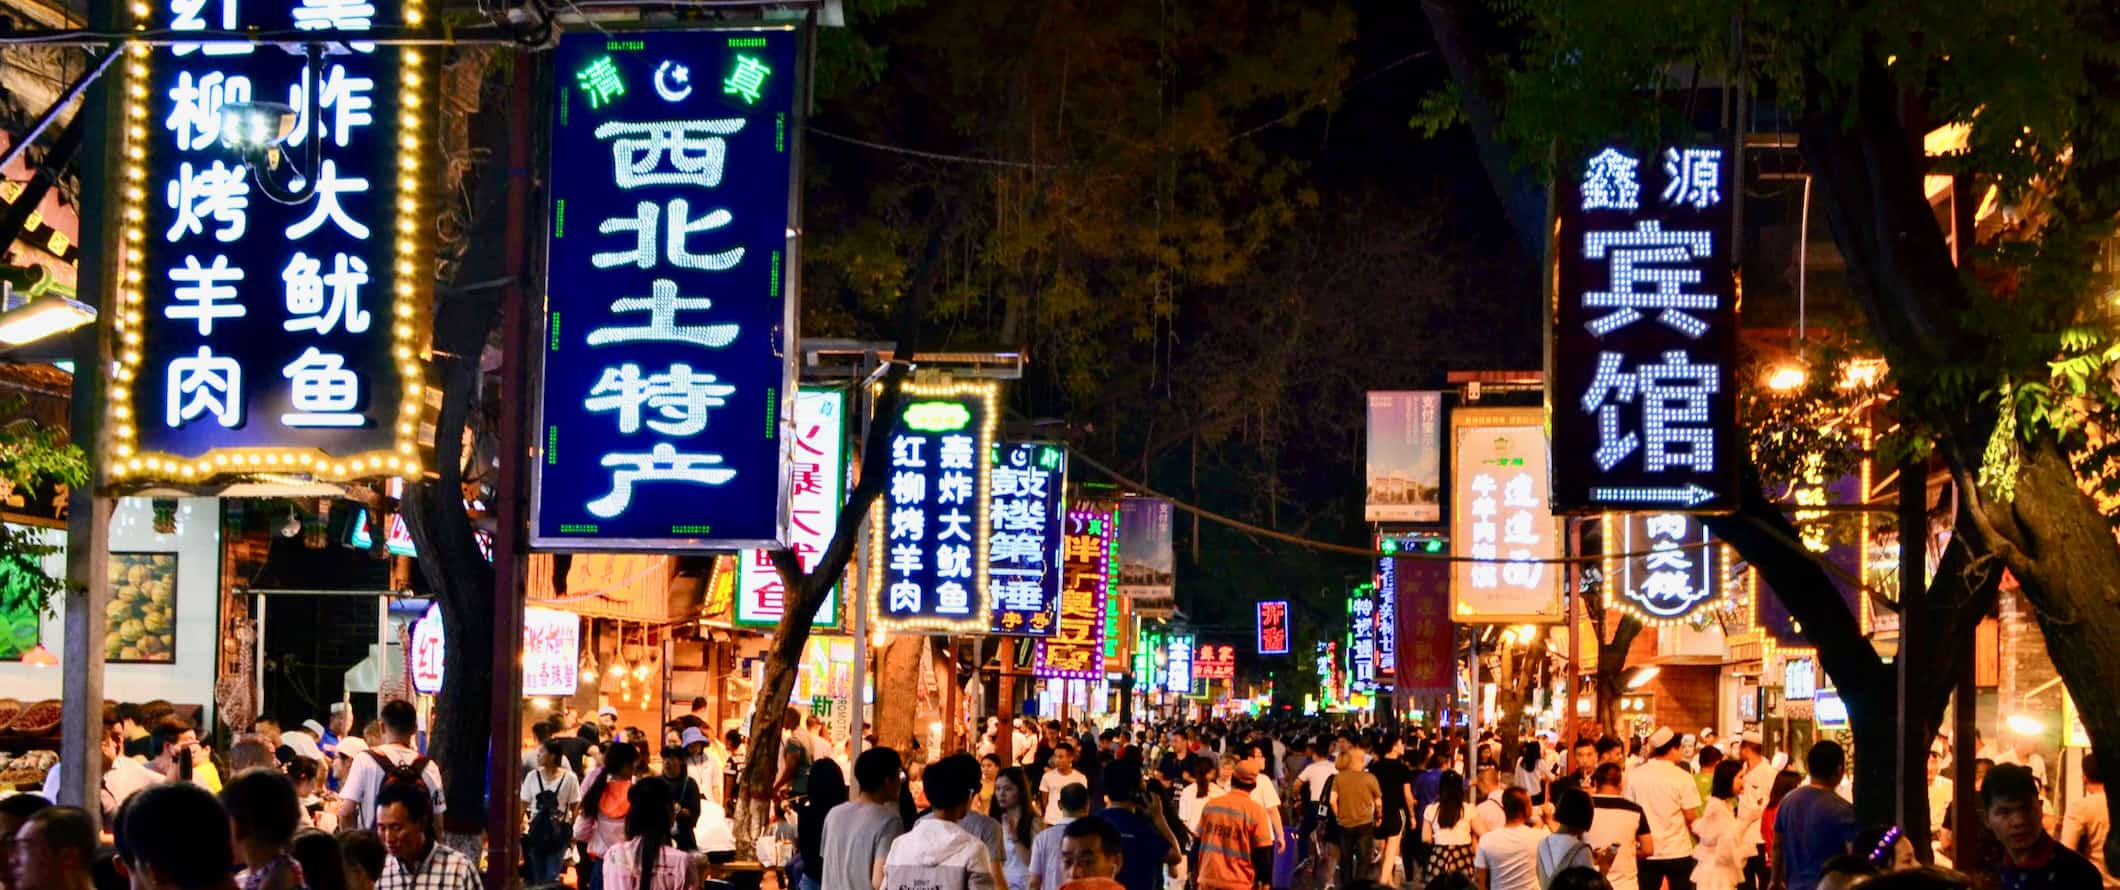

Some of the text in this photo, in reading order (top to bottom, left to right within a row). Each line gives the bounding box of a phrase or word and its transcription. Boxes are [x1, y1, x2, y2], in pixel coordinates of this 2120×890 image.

[576, 54, 771, 109] 清 真
[1579, 147, 1722, 211] 鑫源
[585, 117, 746, 518] 西北土特产
[1579, 219, 1721, 472] 宾馆
[890, 434, 927, 613] 红柳烤羊肉
[935, 434, 974, 614] 轰炸大鱿鱼
